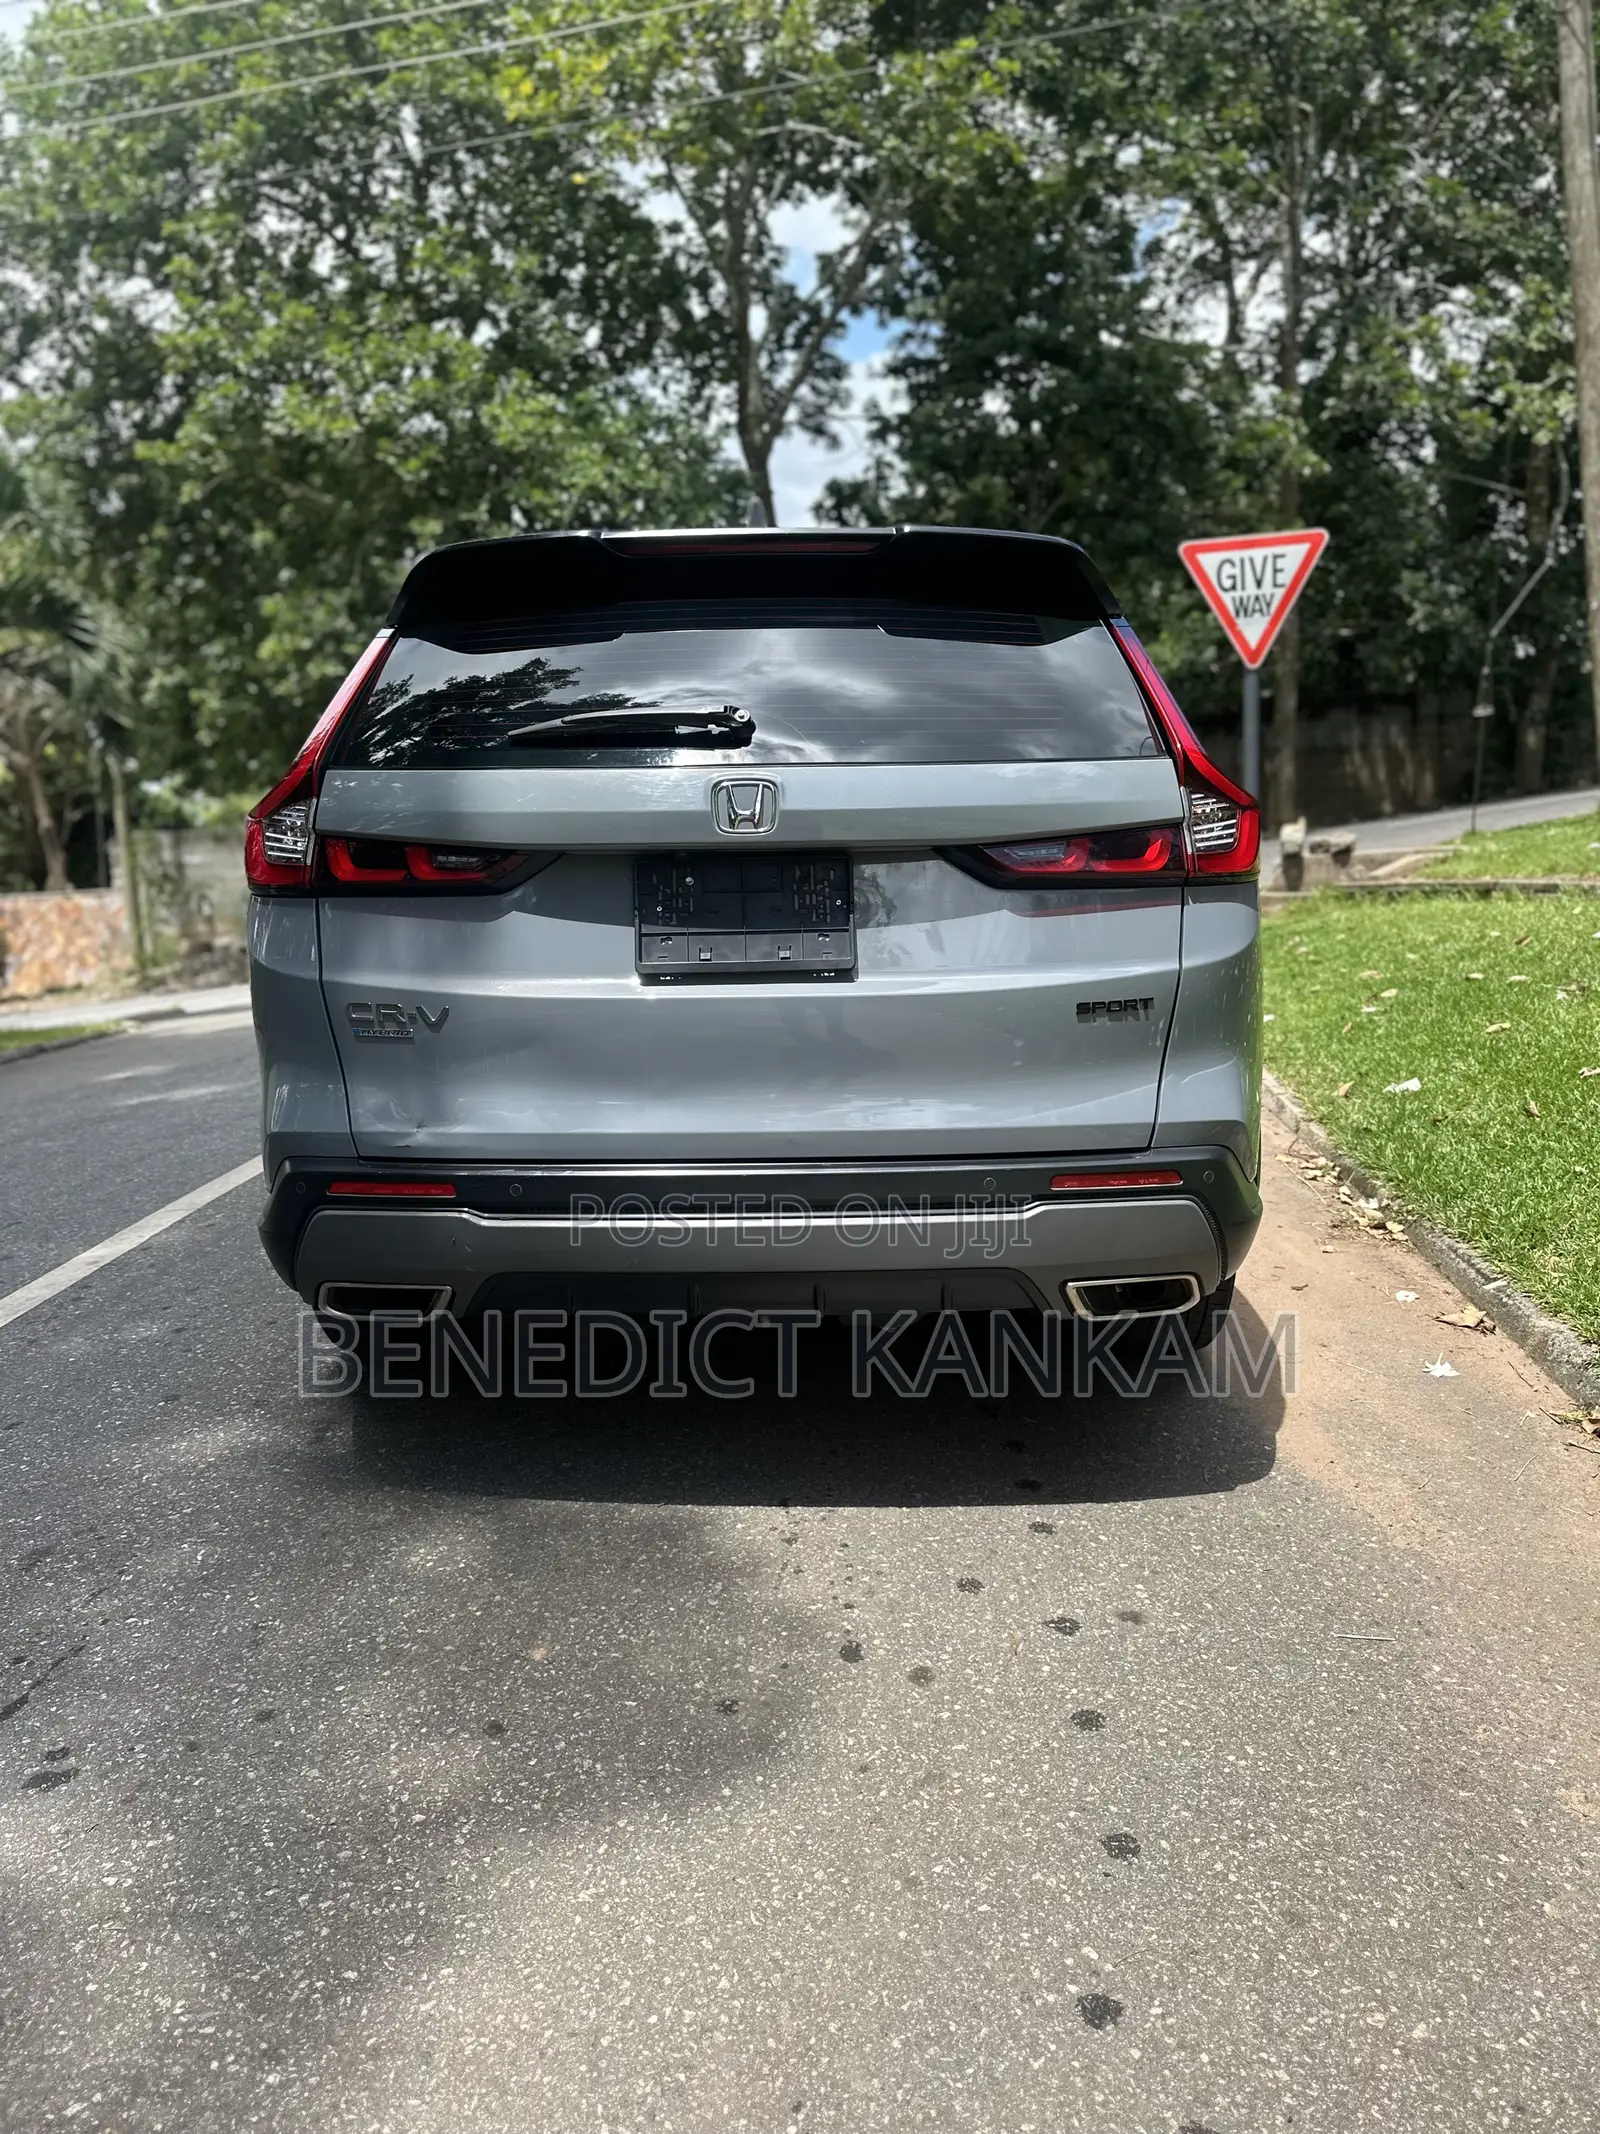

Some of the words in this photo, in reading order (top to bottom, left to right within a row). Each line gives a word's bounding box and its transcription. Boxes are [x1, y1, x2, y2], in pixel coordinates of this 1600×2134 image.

[1216, 553, 1287, 593] GIVE
[1231, 593, 1276, 619] WAY
[345, 1002, 450, 1028] CR-V
[1076, 997, 1154, 1015] SPORT
